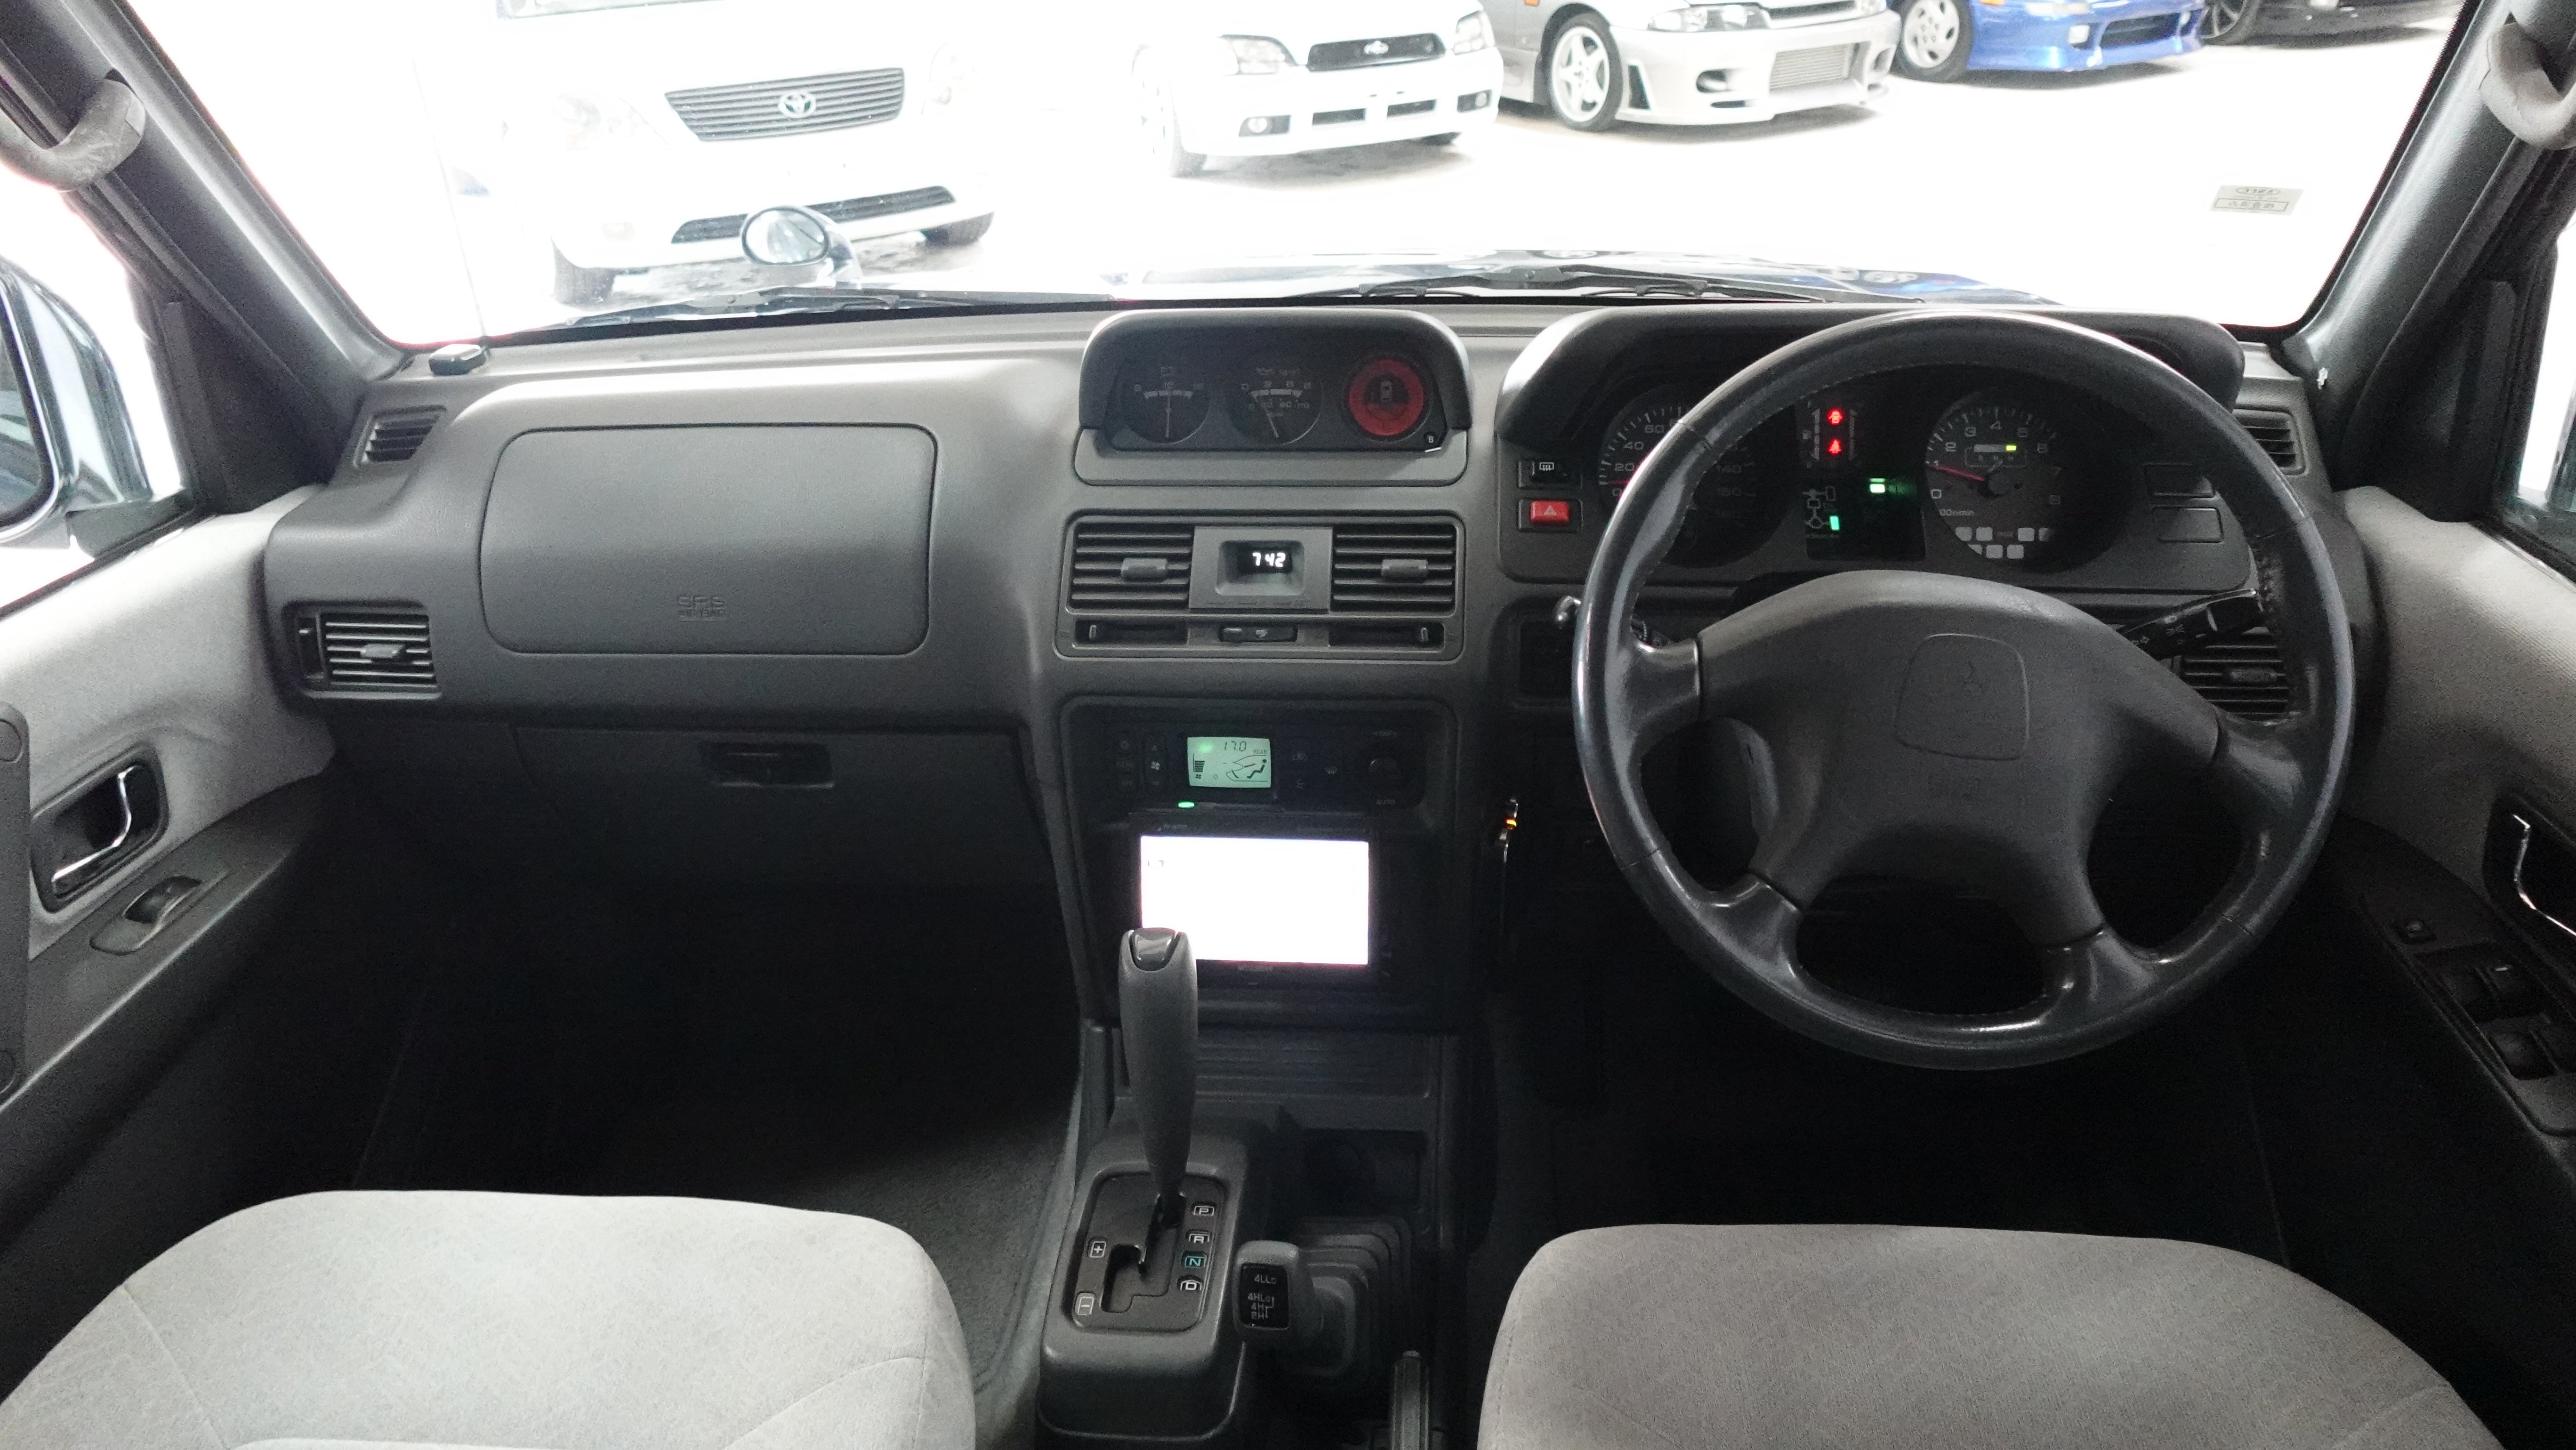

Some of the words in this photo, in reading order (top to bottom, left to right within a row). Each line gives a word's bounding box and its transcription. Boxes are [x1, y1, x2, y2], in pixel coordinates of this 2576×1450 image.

[1644, 425, 1665, 434] 60
[1990, 421, 2002, 430] 4
[1624, 441, 1644, 451] 40
[1945, 441, 1956, 452] 2
[1614, 462, 1635, 472] 20
[1224, 741, 1247, 752] 17.0
[1199, 1208, 1209, 1216] P
[1193, 1235, 1204, 1244] R
[1189, 1258, 1201, 1266] N
